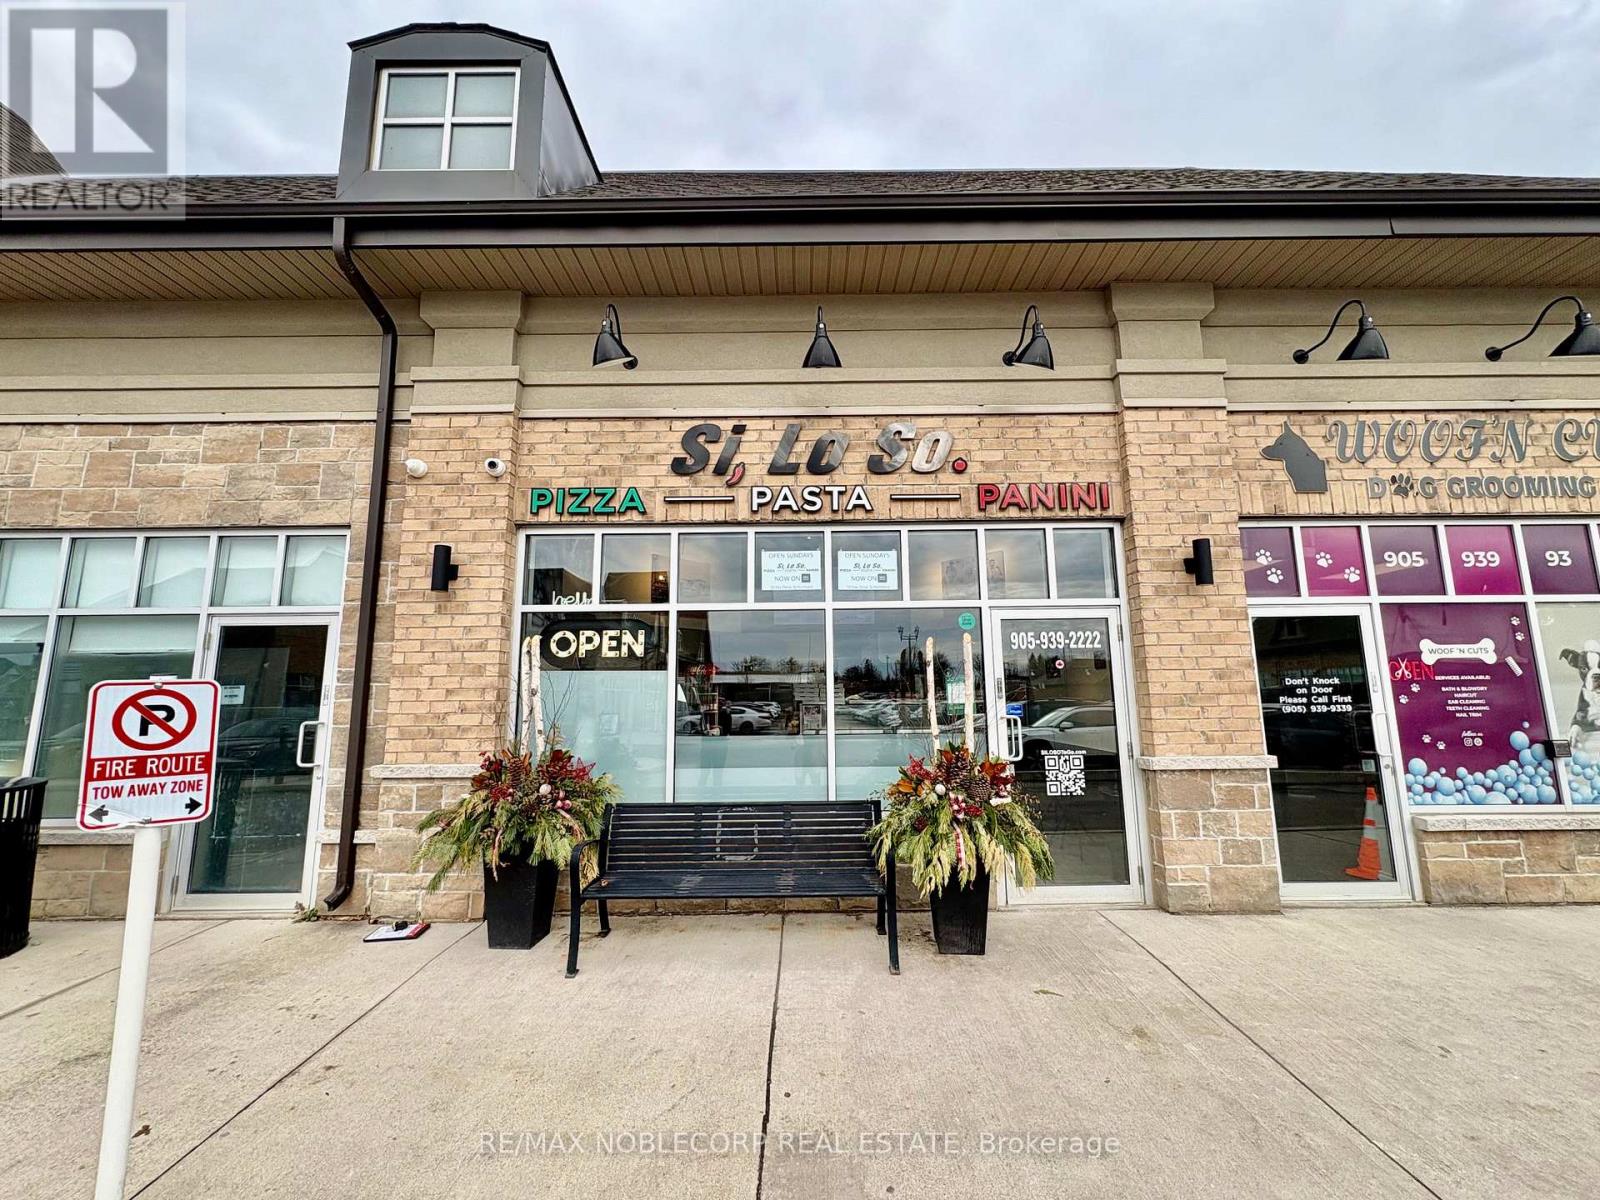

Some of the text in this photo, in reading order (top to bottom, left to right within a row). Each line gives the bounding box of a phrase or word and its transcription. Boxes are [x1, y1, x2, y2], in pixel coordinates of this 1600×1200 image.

[768, 423, 850, 475] Lo
[1446, 475, 1598, 499] GROOMING
[530, 482, 1110, 515] PIZZA PASTA PANINI
[1383, 550, 1572, 568] 905 939 93
[550, 629, 645, 658] OPEN
[1010, 630, 1101, 650] 905-939-2222
[1285, 676, 1340, 685] Don't Knock
[1311, 686, 1333, 694] Door
[1282, 704, 1352, 714] (905) 939-9339
[1311, 695, 1328, 703] Call
[1332, 695, 1352, 703] First
[93, 754, 206, 779] FIRE ROUTE
[92, 779, 204, 801] TOW AWAY ZONE
